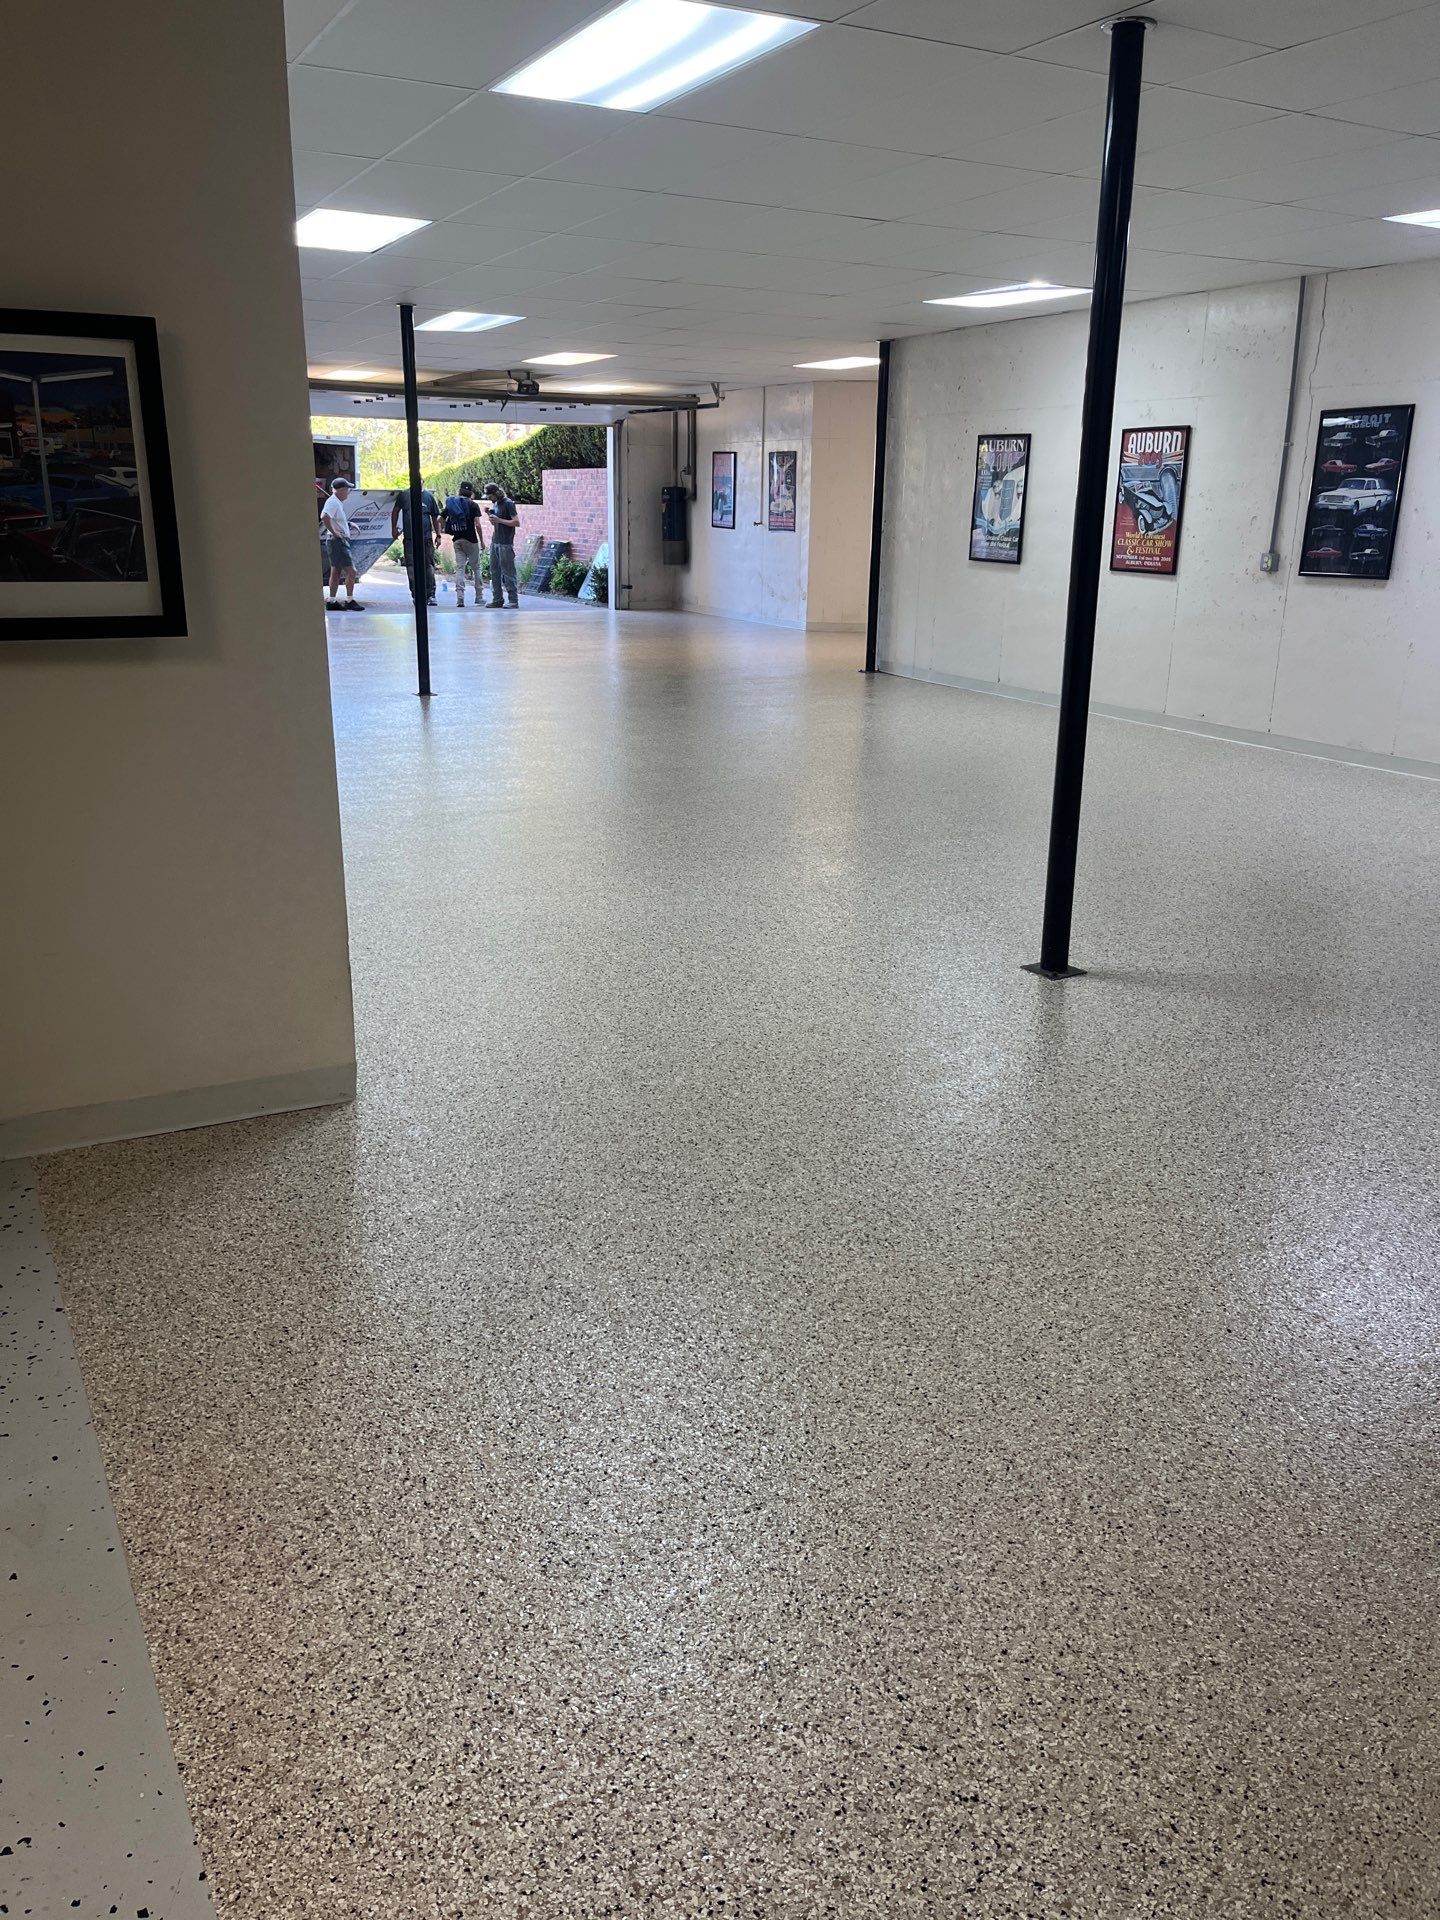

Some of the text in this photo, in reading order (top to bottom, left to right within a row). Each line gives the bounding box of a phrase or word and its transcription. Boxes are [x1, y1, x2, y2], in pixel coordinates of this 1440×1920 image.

[980, 439, 1025, 453] AUBURN
[1128, 431, 1182, 454] AUBURN
[1125, 531, 1143, 539] World's
[1117, 538, 1142, 546] CLASSIC
[1154, 540, 1173, 548] SHOW
[1126, 545, 1162, 555] & FESTIVAL
